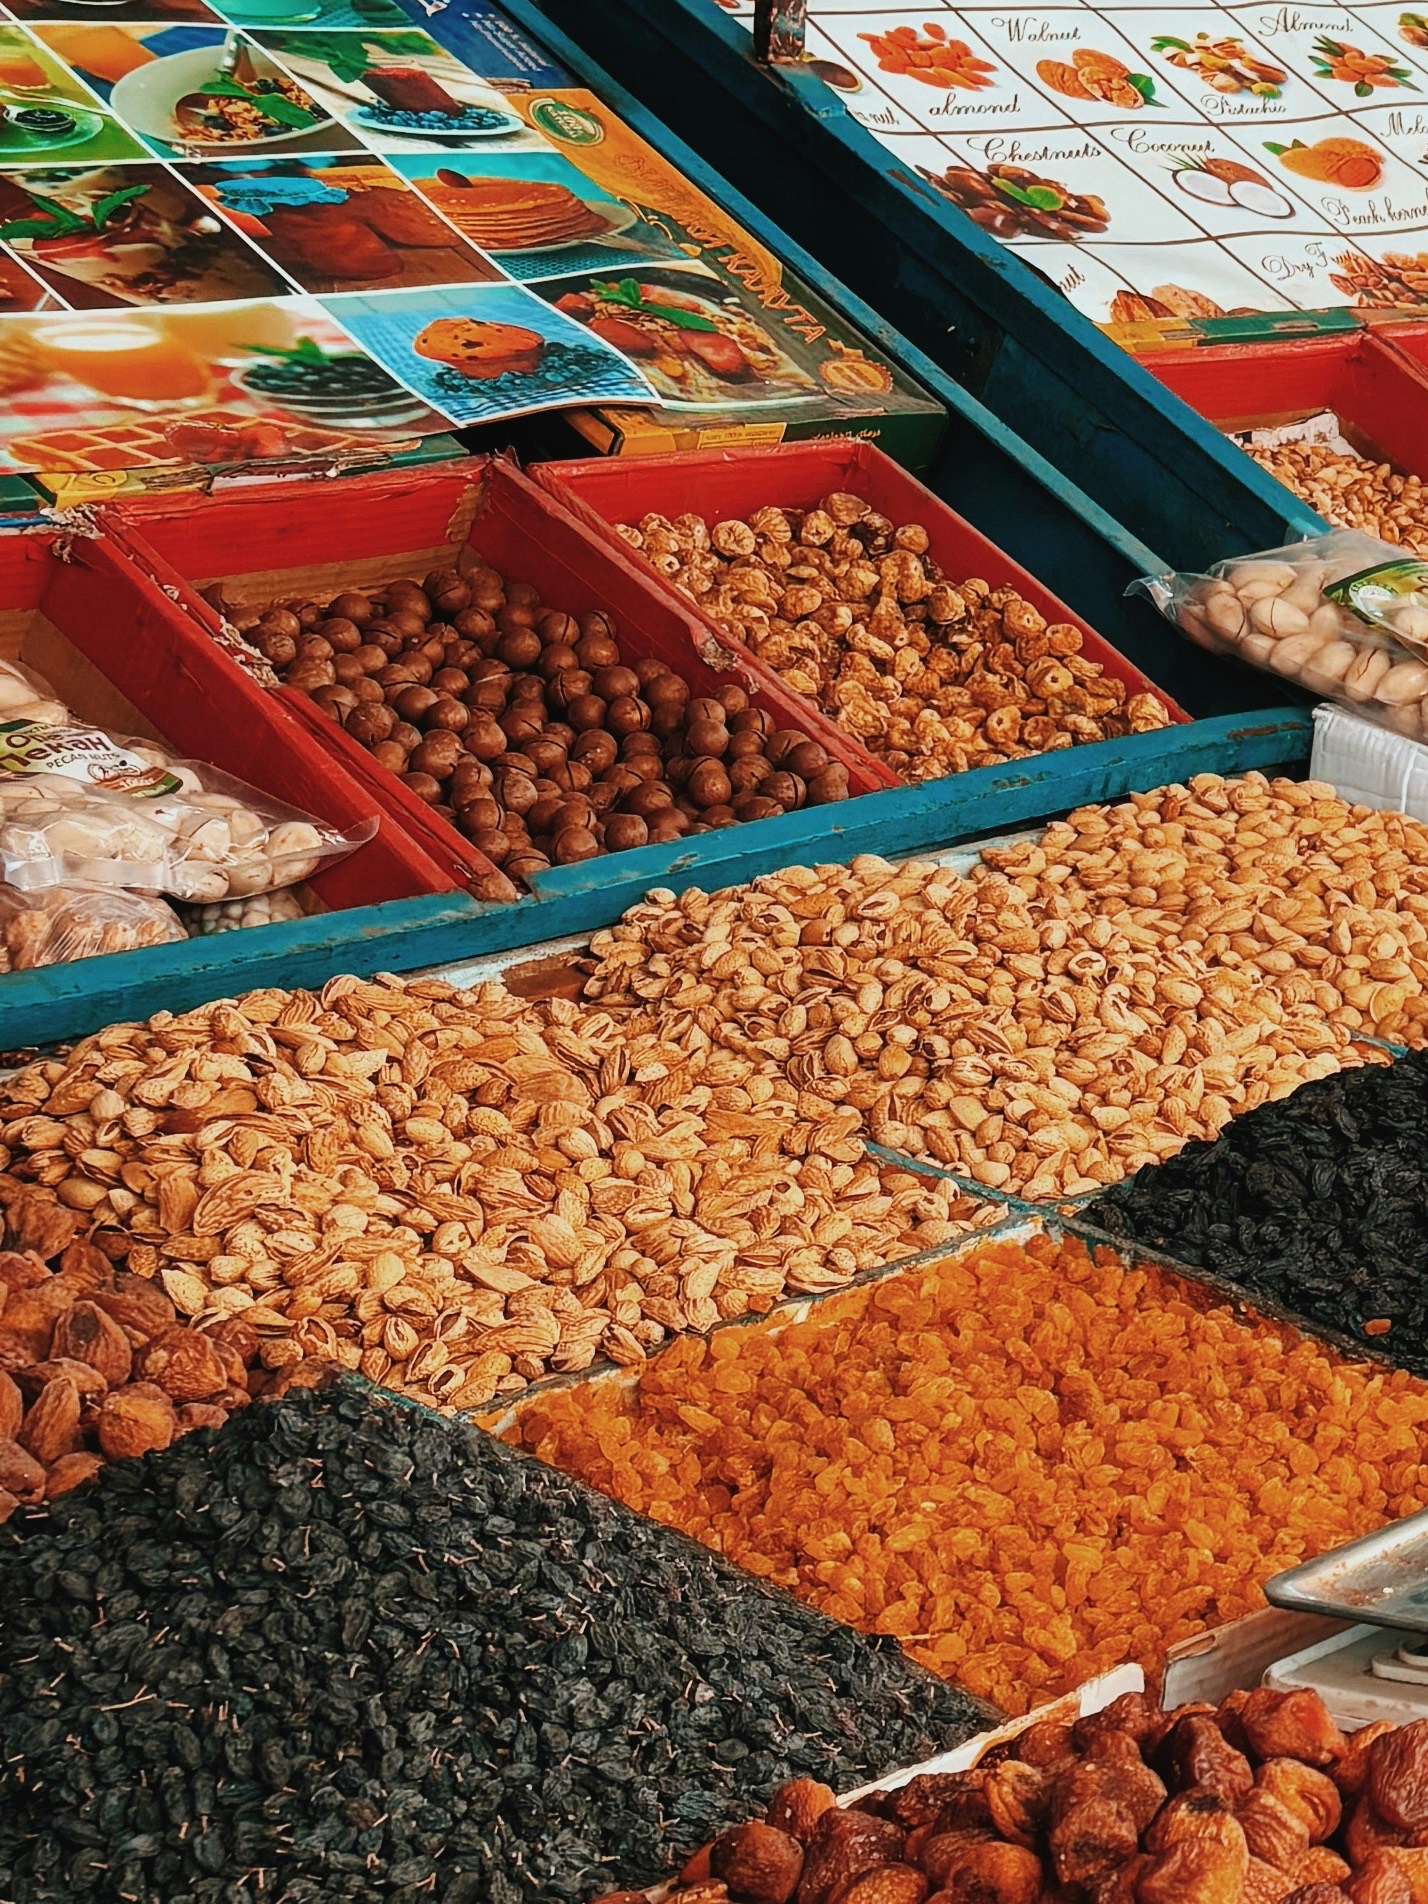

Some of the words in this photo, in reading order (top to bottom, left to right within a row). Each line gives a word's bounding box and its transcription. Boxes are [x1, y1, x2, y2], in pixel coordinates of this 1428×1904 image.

[990, 15, 1082, 43] Walnut
[929, 91, 1021, 116] almond
[966, 136, 1103, 164] Chestnuts
[1110, 127, 1216, 154] Coconut
